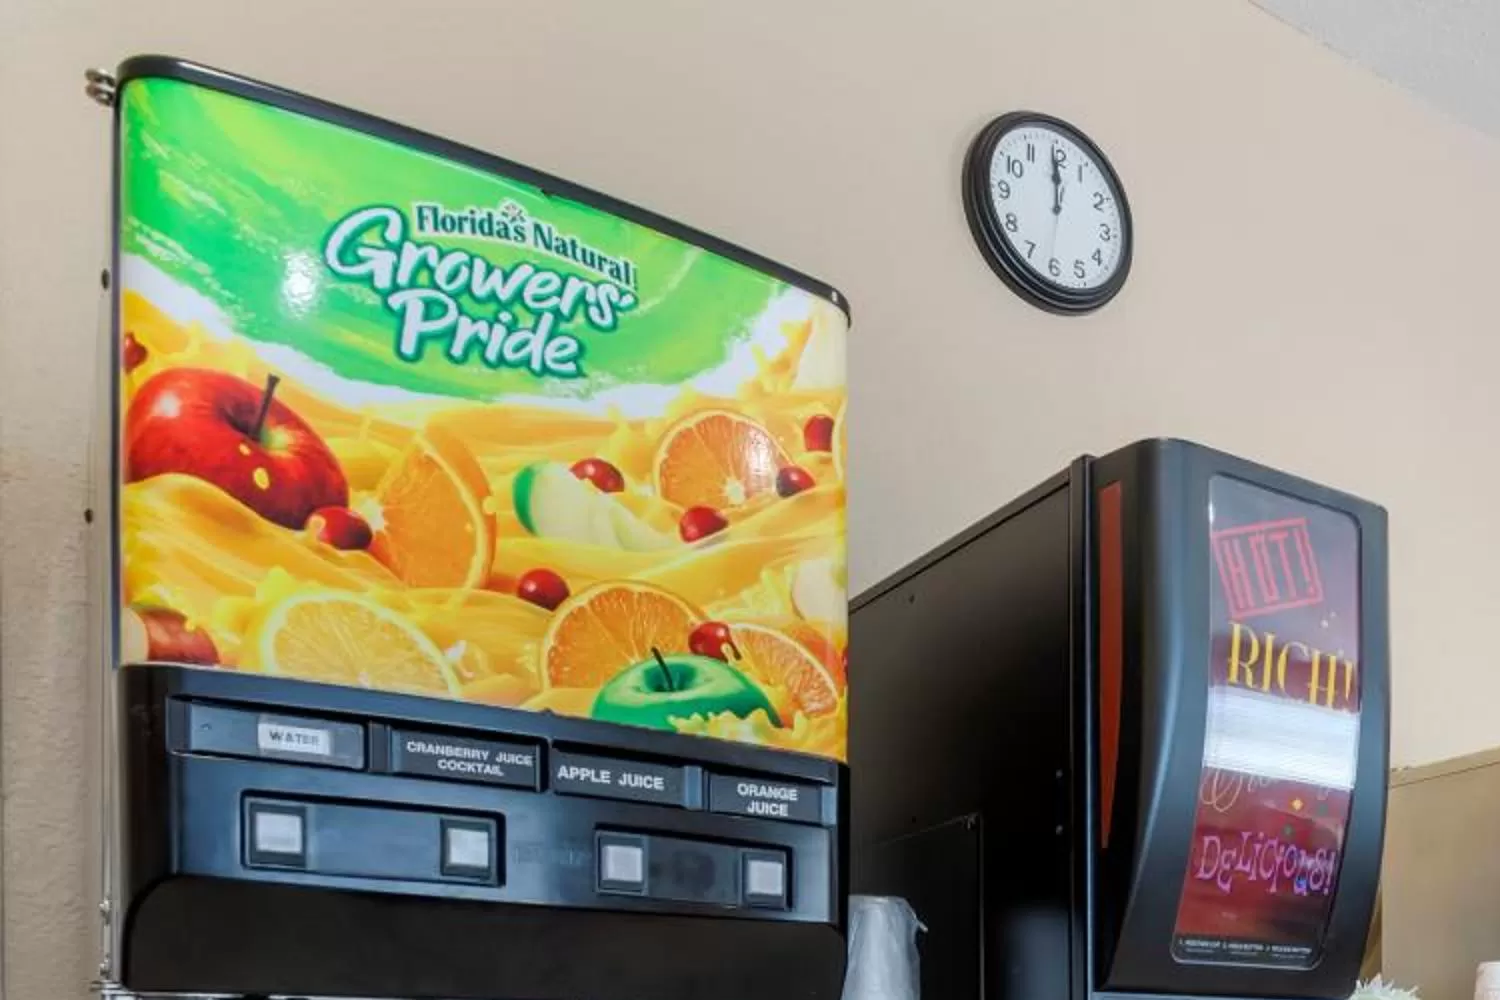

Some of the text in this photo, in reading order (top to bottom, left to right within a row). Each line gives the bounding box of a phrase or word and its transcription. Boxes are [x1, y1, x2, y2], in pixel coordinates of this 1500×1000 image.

[1027, 143, 1035, 164] 11
[1007, 155, 1024, 178] 10
[1077, 164, 1083, 183] 1
[997, 180, 1011, 200] 9
[1092, 191, 1105, 213] 2
[1005, 212, 1018, 232] 8
[1099, 223, 1112, 242] 3
[532, 222, 630, 287] Natural
[1024, 239, 1037, 259] 7
[1091, 248, 1104, 267] 4
[1048, 258, 1061, 277] 6
[1073, 259, 1086, 279] 5
[387, 287, 579, 374] Pride
[268, 730, 321, 747] WATER
[406, 740, 535, 767] CRANBERRY JUICE
[437, 759, 505, 777] COCKTAIL
[557, 765, 666, 790] APPLE JUICE
[737, 783, 800, 801] ORANGE
[747, 801, 790, 817] JUICE
